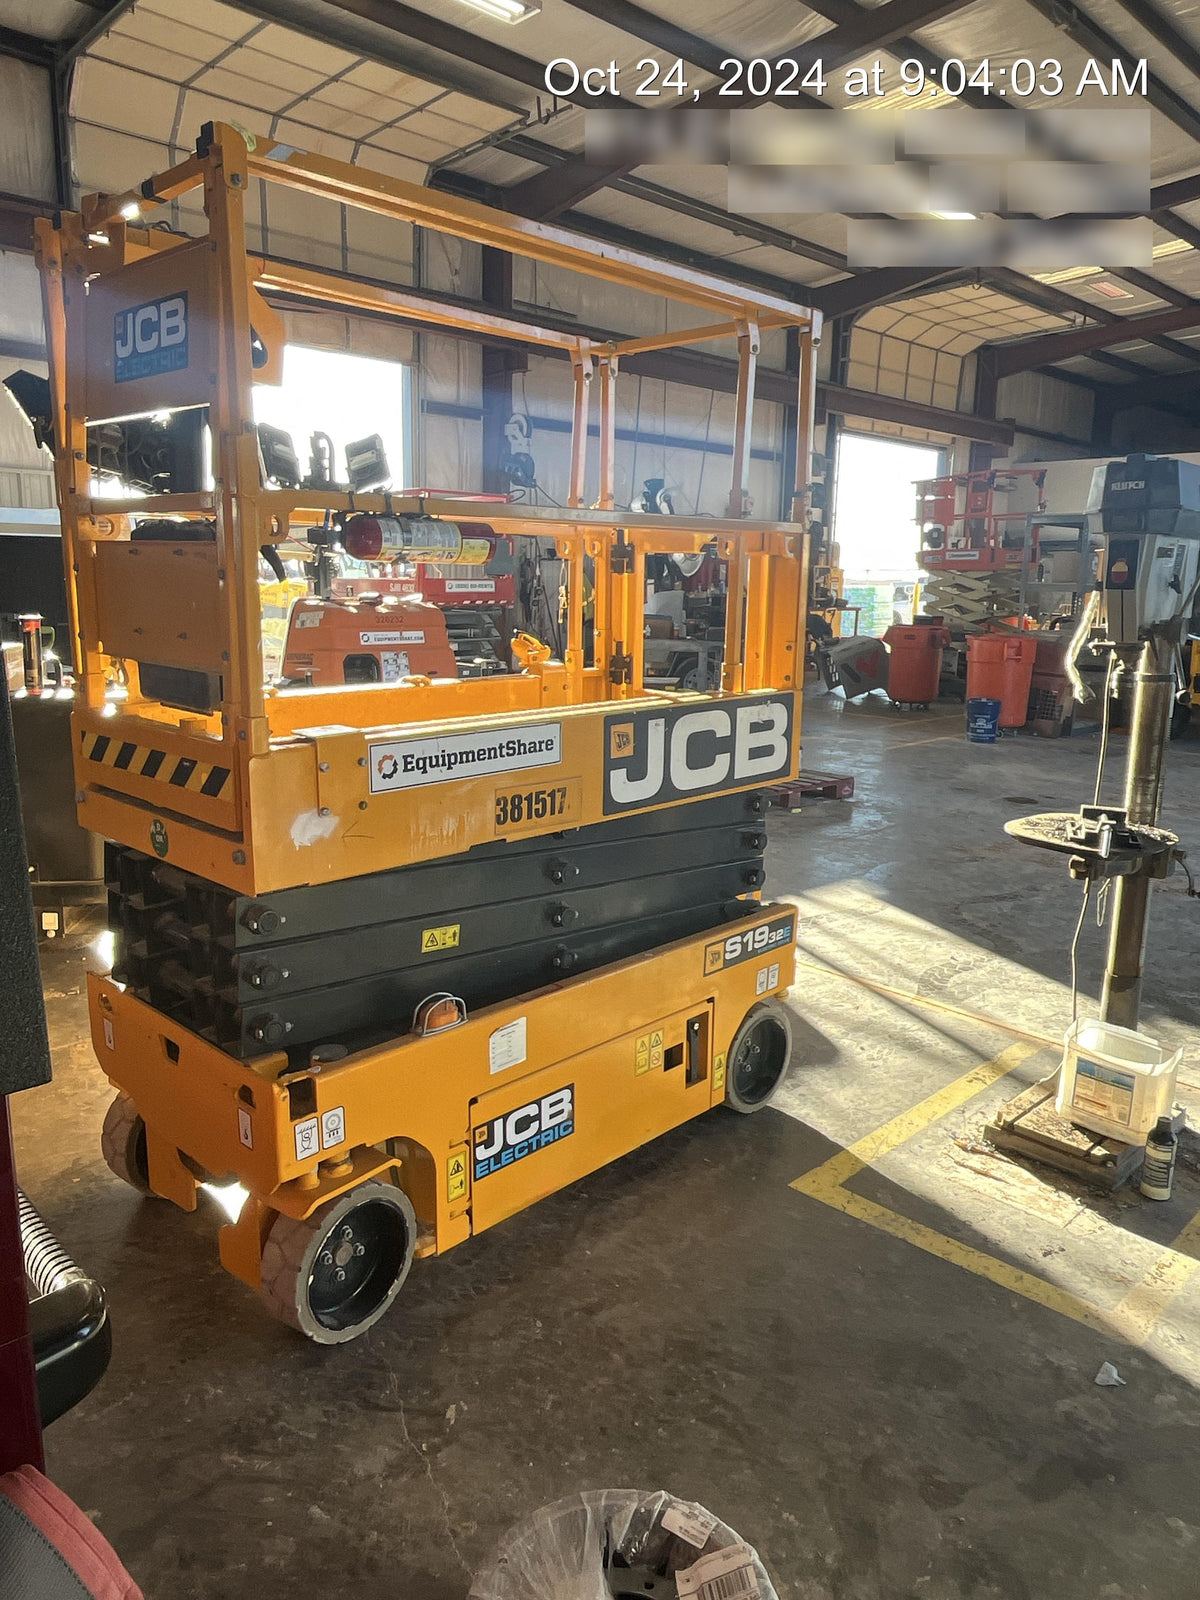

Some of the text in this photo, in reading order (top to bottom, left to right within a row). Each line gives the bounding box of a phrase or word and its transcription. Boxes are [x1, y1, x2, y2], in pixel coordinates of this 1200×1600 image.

[115, 297, 187, 359] JCB
[402, 738, 554, 775] EquipmentShare
[609, 702, 788, 804] JCB
[495, 786, 567, 826] 381517
[475, 1088, 573, 1161] JCB
[475, 1120, 573, 1180] ELECTRIC
